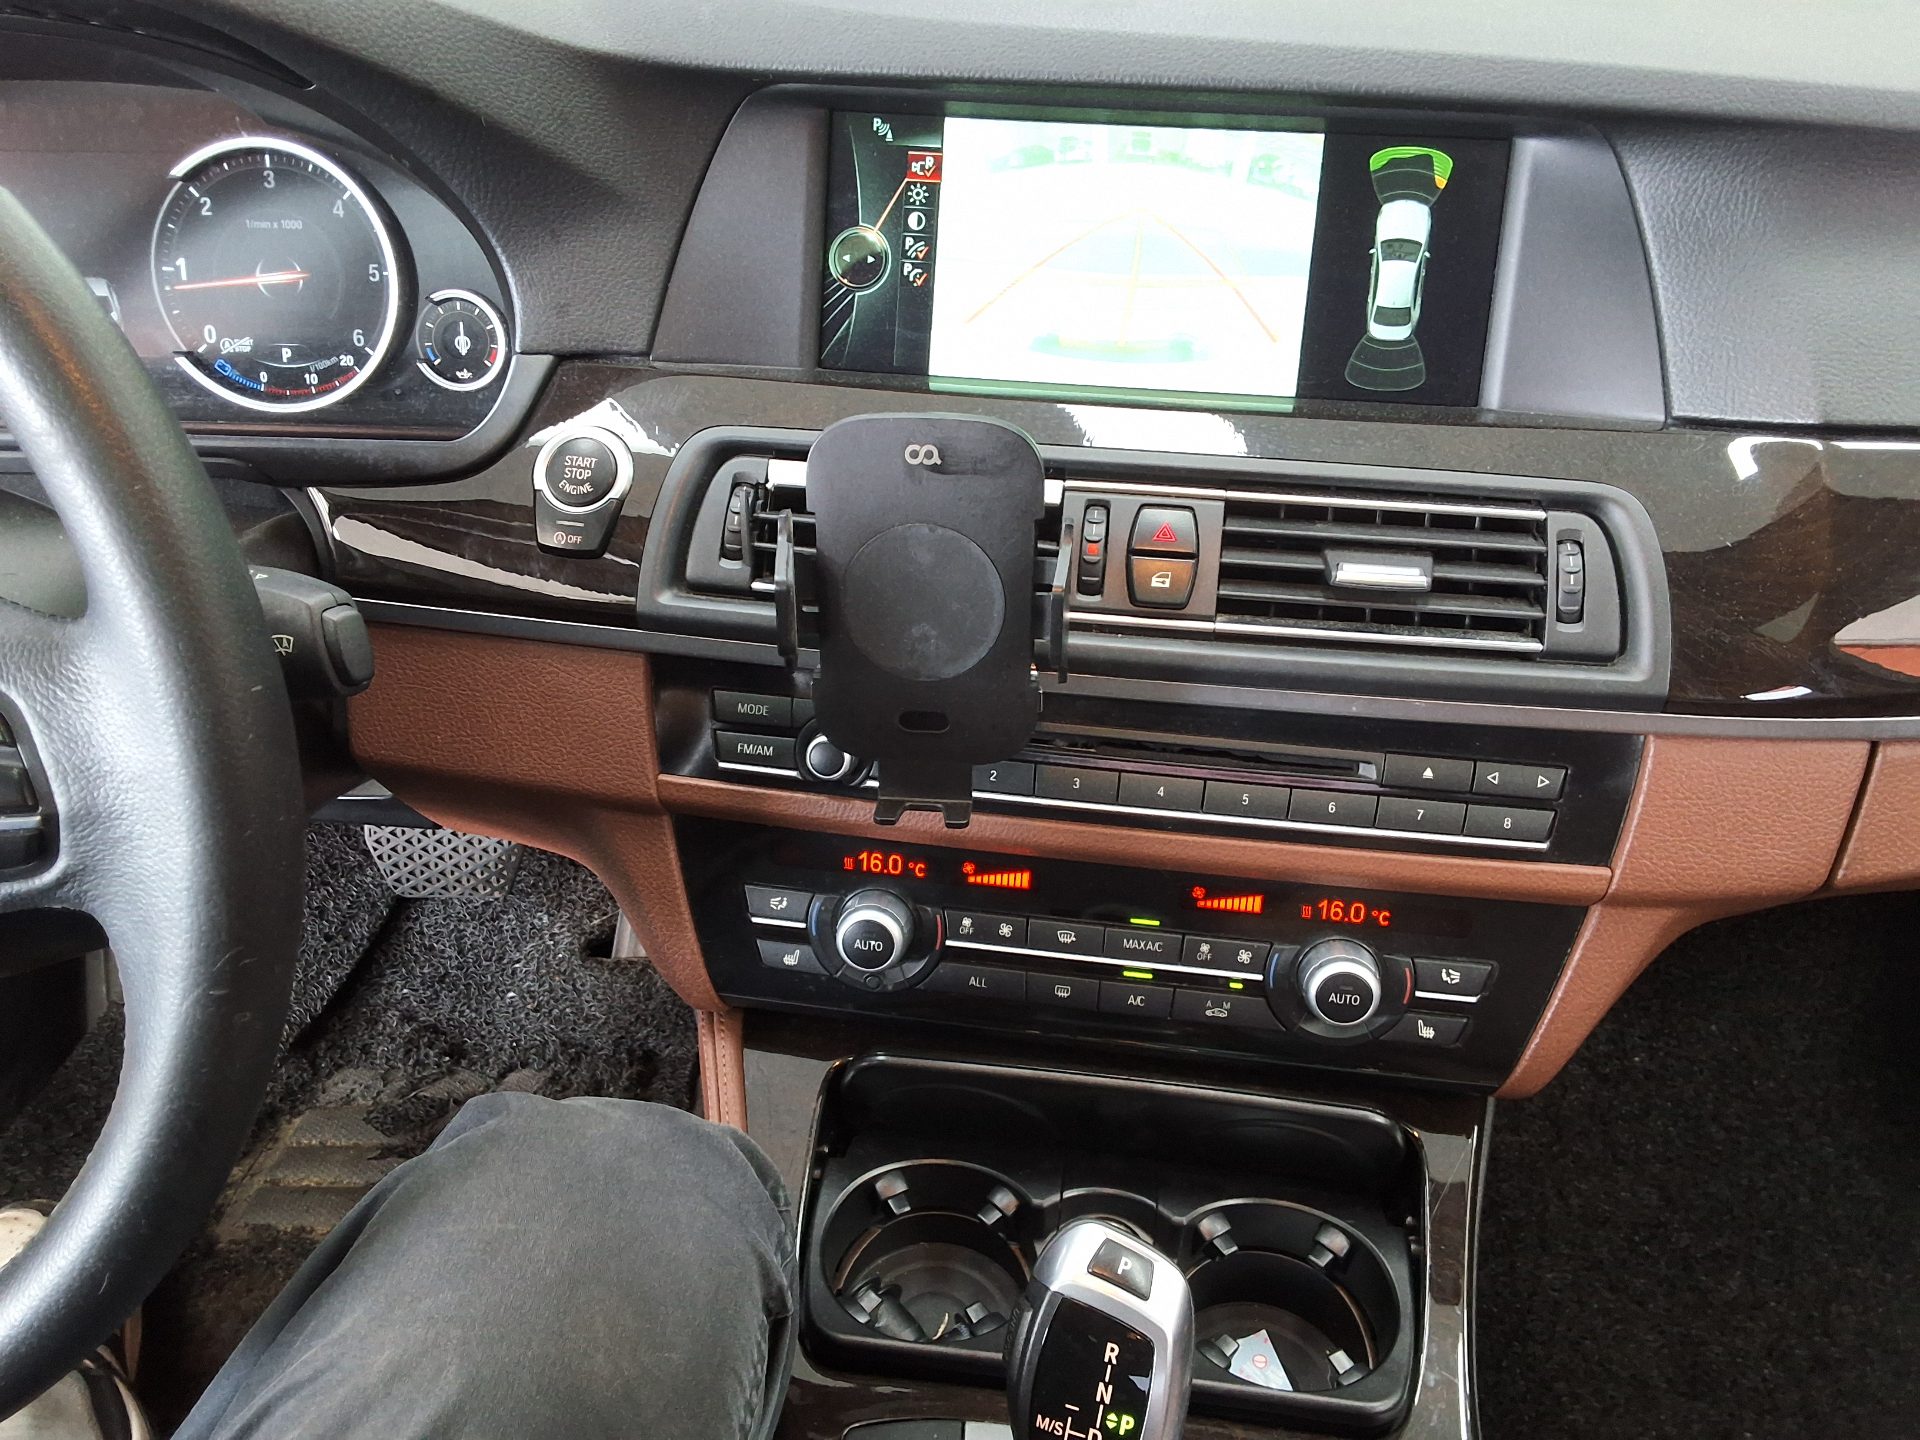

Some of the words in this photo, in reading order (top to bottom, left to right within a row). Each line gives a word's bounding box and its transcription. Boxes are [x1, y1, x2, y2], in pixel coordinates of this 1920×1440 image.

[263, 170, 275, 188] 3
[200, 198, 212, 216] 2
[332, 200, 344, 218] 4
[280, 219, 302, 230] 1000
[176, 258, 188, 280] 1
[368, 264, 380, 282] 5
[204, 324, 216, 344] 0
[353, 330, 364, 346] 6
[281, 348, 292, 362] P
[339, 354, 354, 366] 20
[259, 371, 268, 383] 0
[304, 373, 318, 385] 10
[564, 455, 598, 469] START
[564, 468, 592, 480] STOP
[558, 479, 594, 495] ENGINE
[567, 534, 582, 544] OFF
[737, 702, 769, 716] MODE
[737, 742, 774, 756] FM/AM
[990, 770, 997, 781] 2
[1072, 778, 1080, 789] 3
[1157, 786, 1164, 798] 4
[1242, 794, 1249, 805] 5
[1328, 802, 1336, 813] 6
[1416, 810, 1424, 820] 7
[1504, 818, 1512, 829] 8
[858, 852, 902, 875] 16.0
[1318, 900, 1366, 924] 16.0
[959, 926, 975, 936] OFF
[854, 940, 883, 952] AUTO
[1196, 952, 1213, 961] OFF
[968, 976, 987, 988] ALL
[1128, 994, 1145, 1006] A/C
[1328, 993, 1360, 1006] AUTO
[1117, 1256, 1132, 1275] P
[1104, 1342, 1120, 1365] R
[1096, 1382, 1113, 1405] N
[1036, 1414, 1064, 1436] M/S
[1119, 1414, 1135, 1436] P
